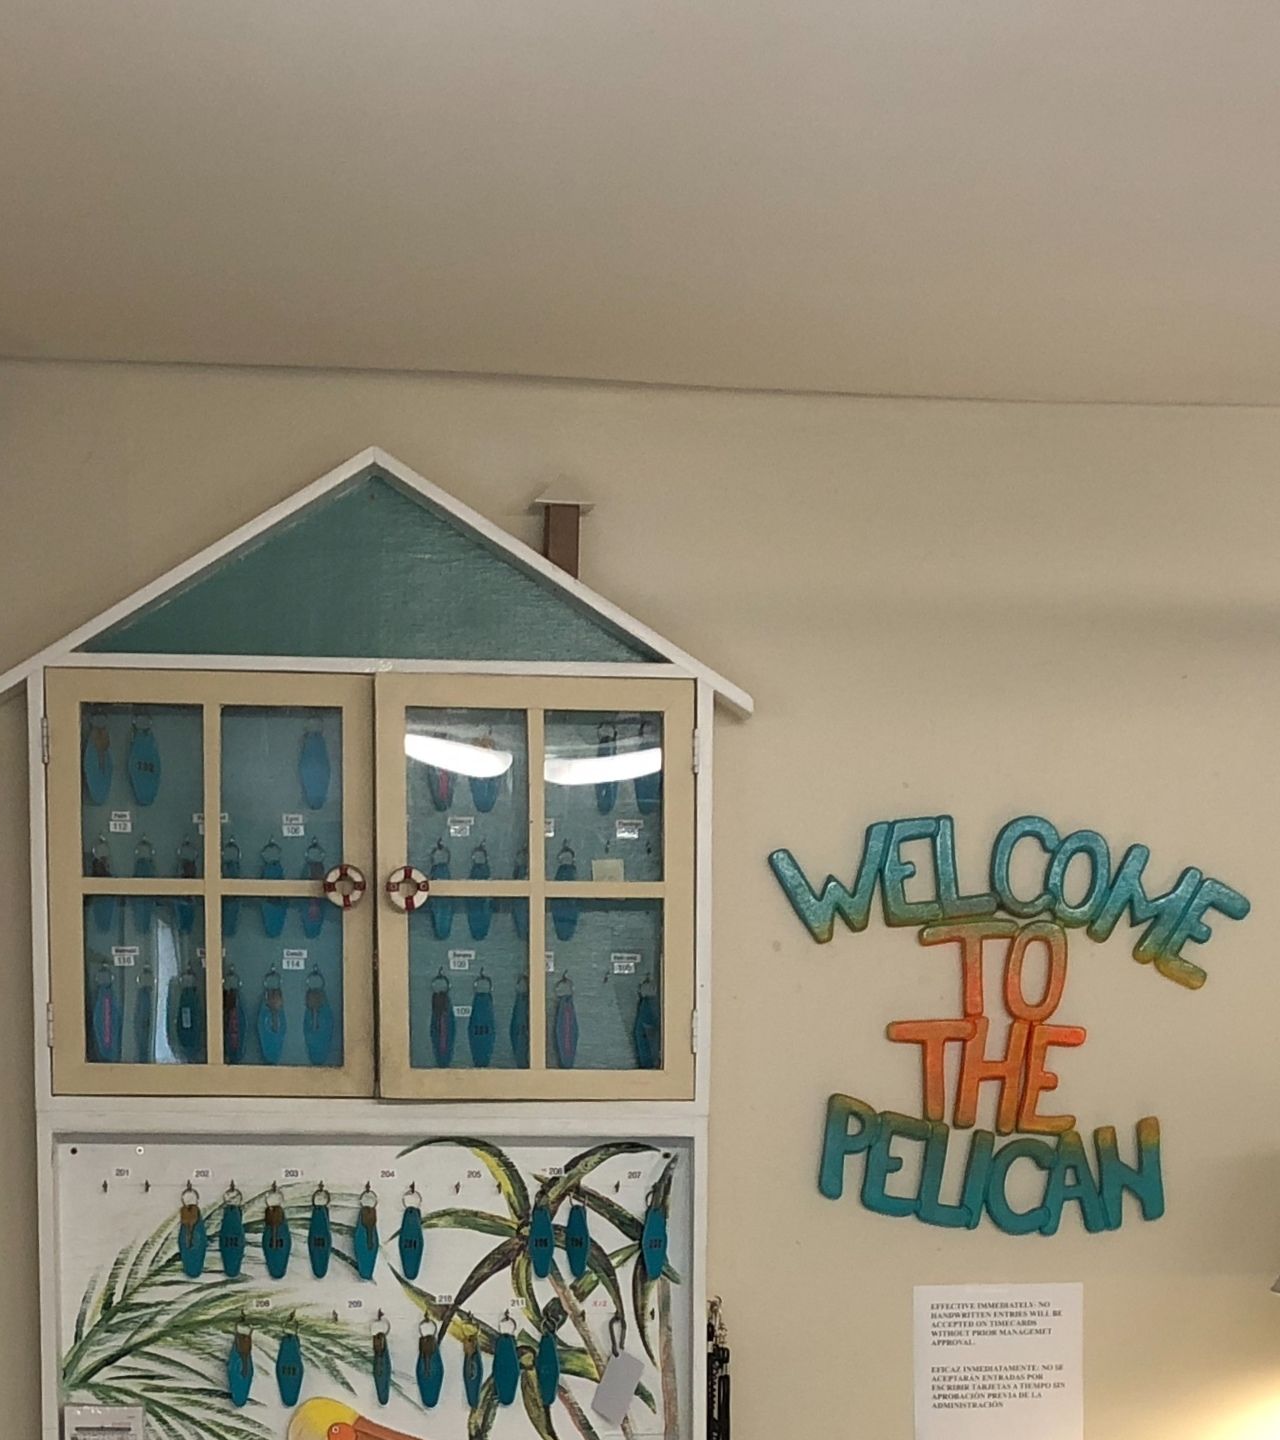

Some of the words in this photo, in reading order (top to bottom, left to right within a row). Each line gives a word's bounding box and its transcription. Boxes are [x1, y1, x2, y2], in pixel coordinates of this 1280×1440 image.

[768, 813, 1251, 990] WELCOME
[917, 919, 1068, 1023] TO
[887, 1014, 1086, 1136] THE
[818, 1092, 1166, 1236] PELICAN
[115, 1168, 130, 1177] 201
[195, 1169, 210, 1178] 202
[284, 1169, 299, 1178] 203
[380, 1170, 395, 1178] 204
[467, 1170, 482, 1179] 205
[931, 1311, 991, 1319] HANDWRITTEN
[994, 1310, 1028, 1318] ENTRIES
[1052, 1309, 1063, 1317] BE
[931, 1320, 974, 1328] ACCEPTED
[990, 1319, 1037, 1327] TIMECARDS
[931, 1329, 970, 1337] WITHOUT
[1020, 1382, 1051, 1390] TIEMPO
